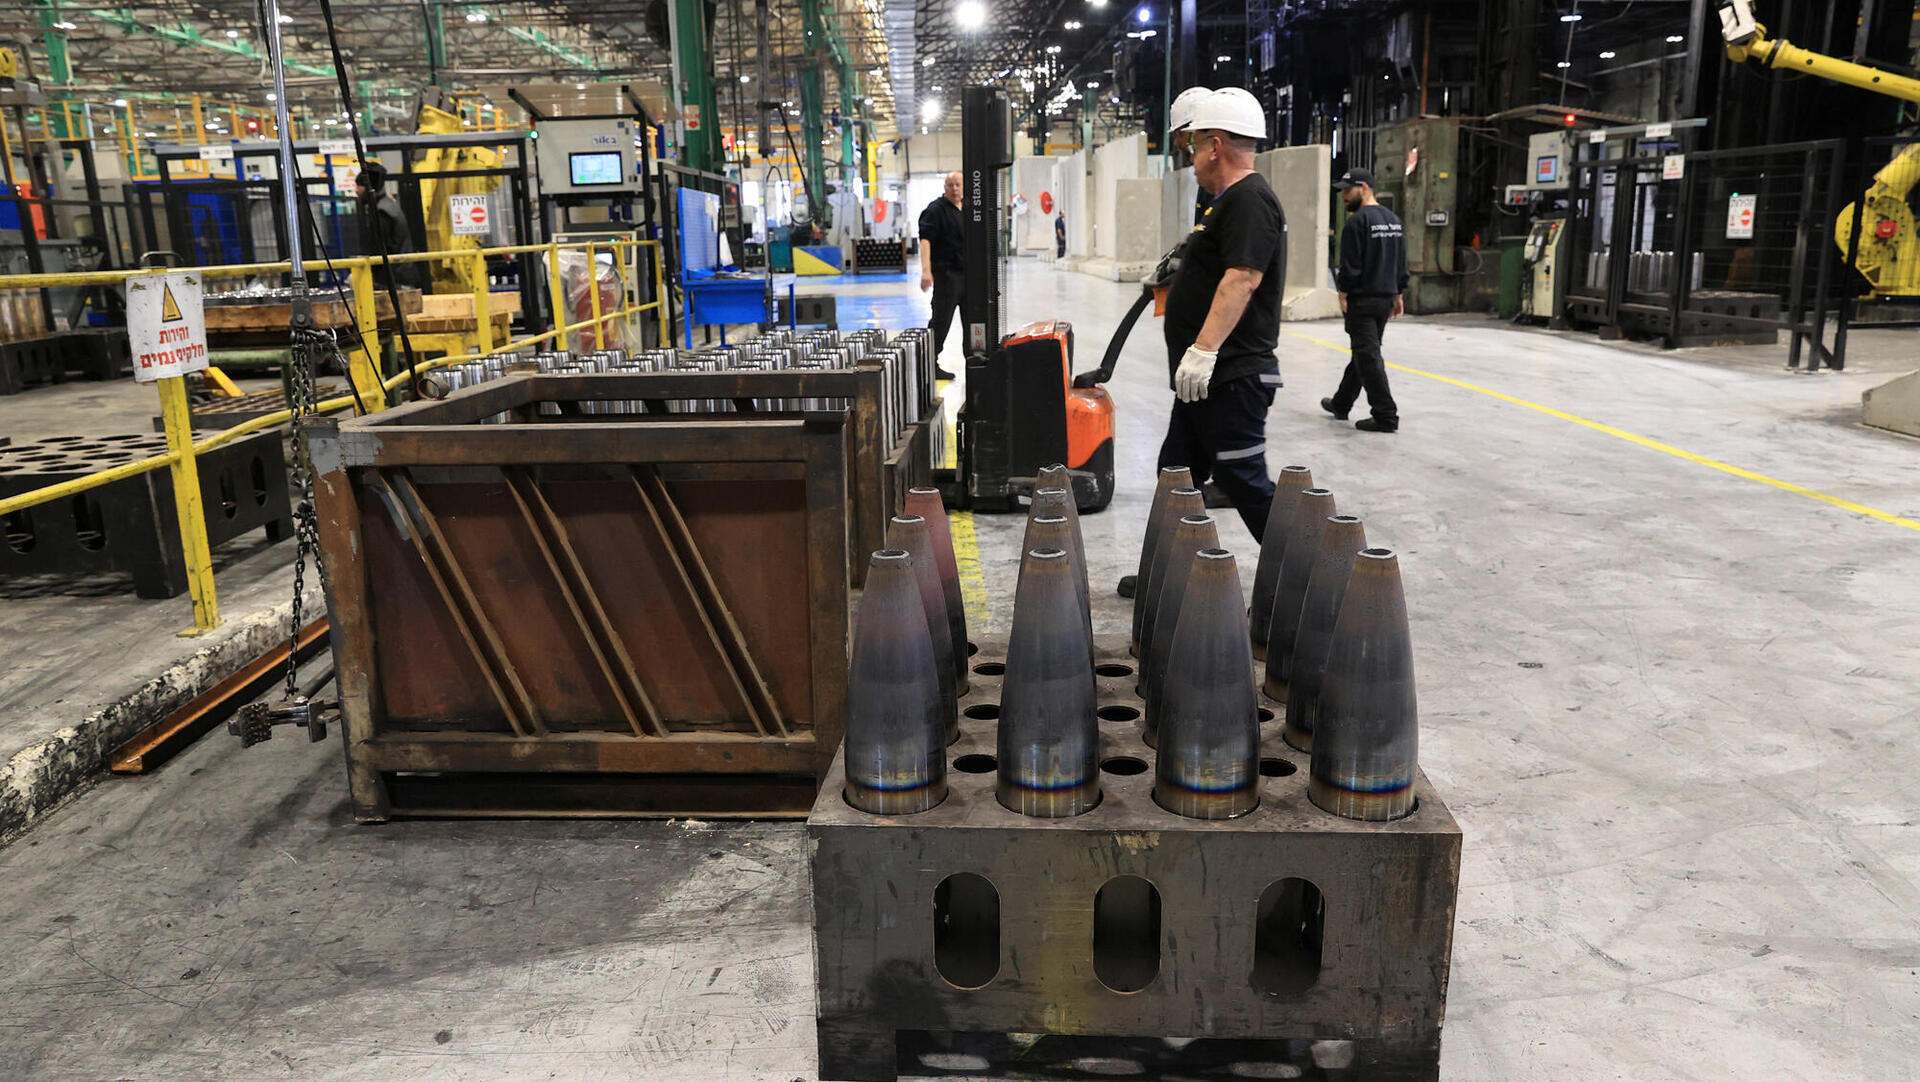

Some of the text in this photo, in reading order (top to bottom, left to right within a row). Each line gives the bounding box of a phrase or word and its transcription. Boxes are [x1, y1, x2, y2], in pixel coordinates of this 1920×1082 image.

[452, 196, 485, 206] זהירות
[972, 170, 982, 222] BT staxio
[159, 326, 189, 344] זהירות
